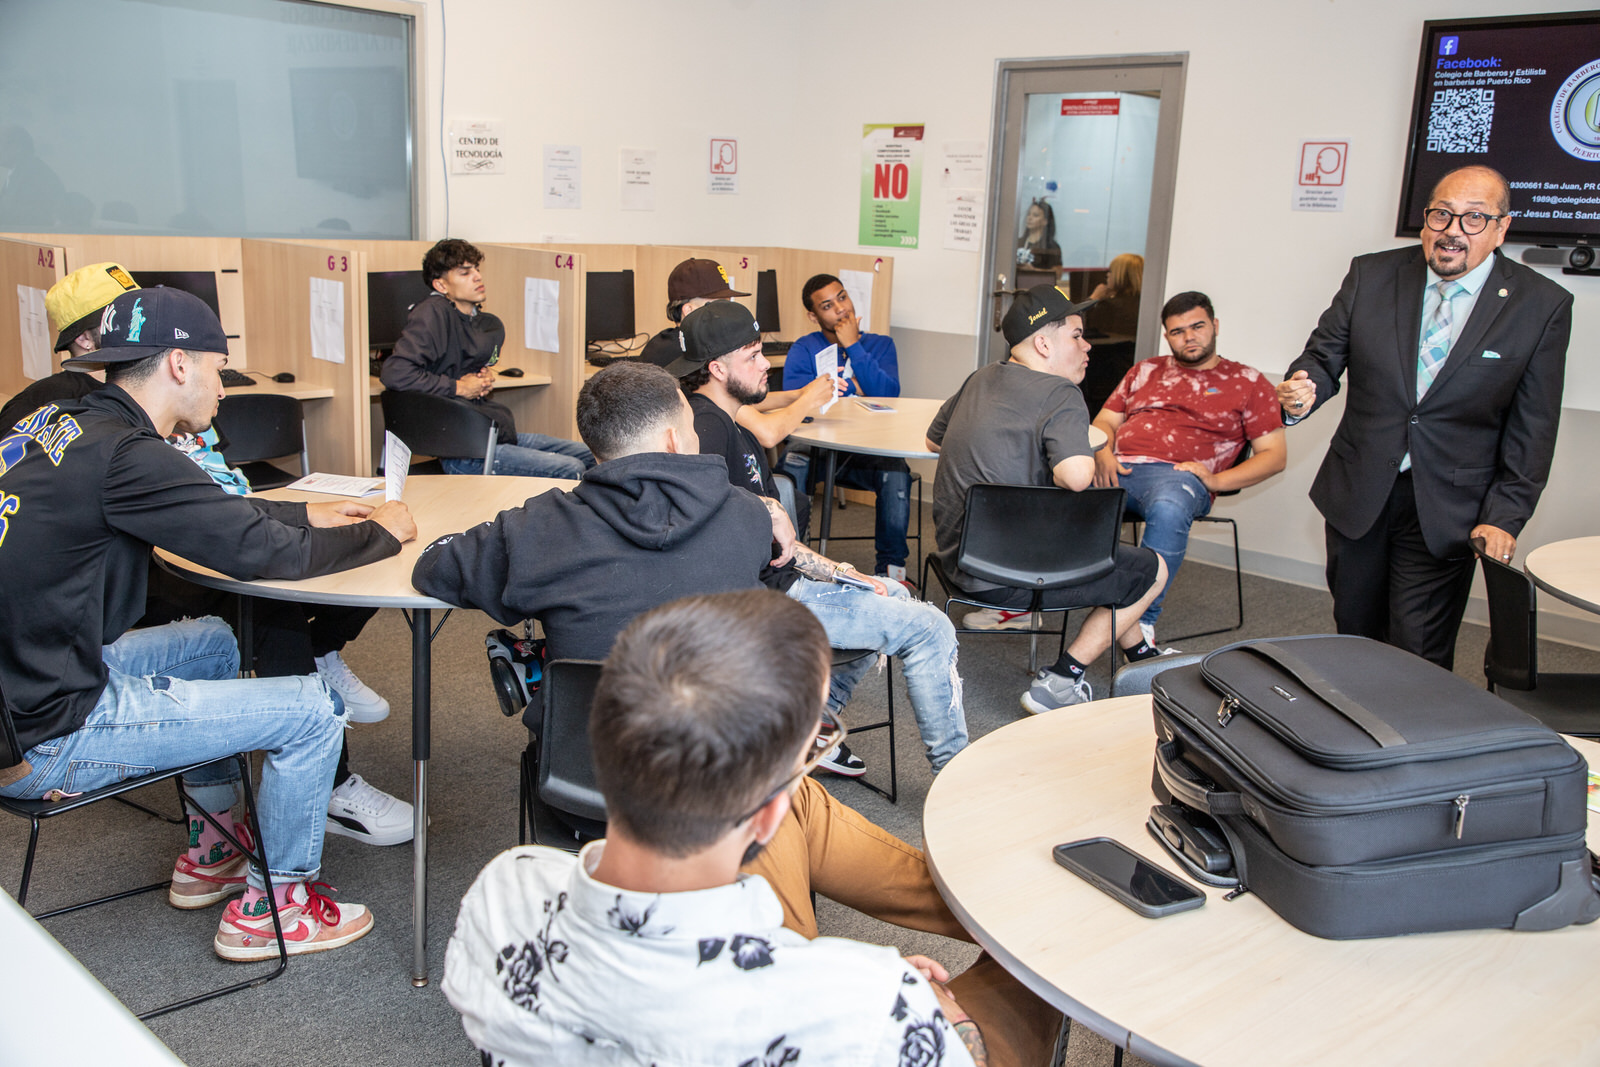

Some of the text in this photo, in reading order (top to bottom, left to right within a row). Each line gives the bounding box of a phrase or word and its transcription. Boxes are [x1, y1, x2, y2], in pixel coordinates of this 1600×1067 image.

[1436, 56, 1502, 69] Facebook:
[1434, 68, 1547, 79] Colegio de Barberos y Estilista
[1486, 77, 1512, 85] Puerto
[458, 137, 499, 146] CENTRO DE
[456, 148, 503, 158] TECNOLOGÍA
[873, 163, 909, 199] NO
[1543, 182, 1559, 190] San
[1560, 182, 1582, 191] Juan,
[1583, 182, 1596, 190] PR
[1523, 208, 1551, 218] Jesus
[1552, 210, 1574, 219] Diaz
[327, 255, 348, 272] G 3
